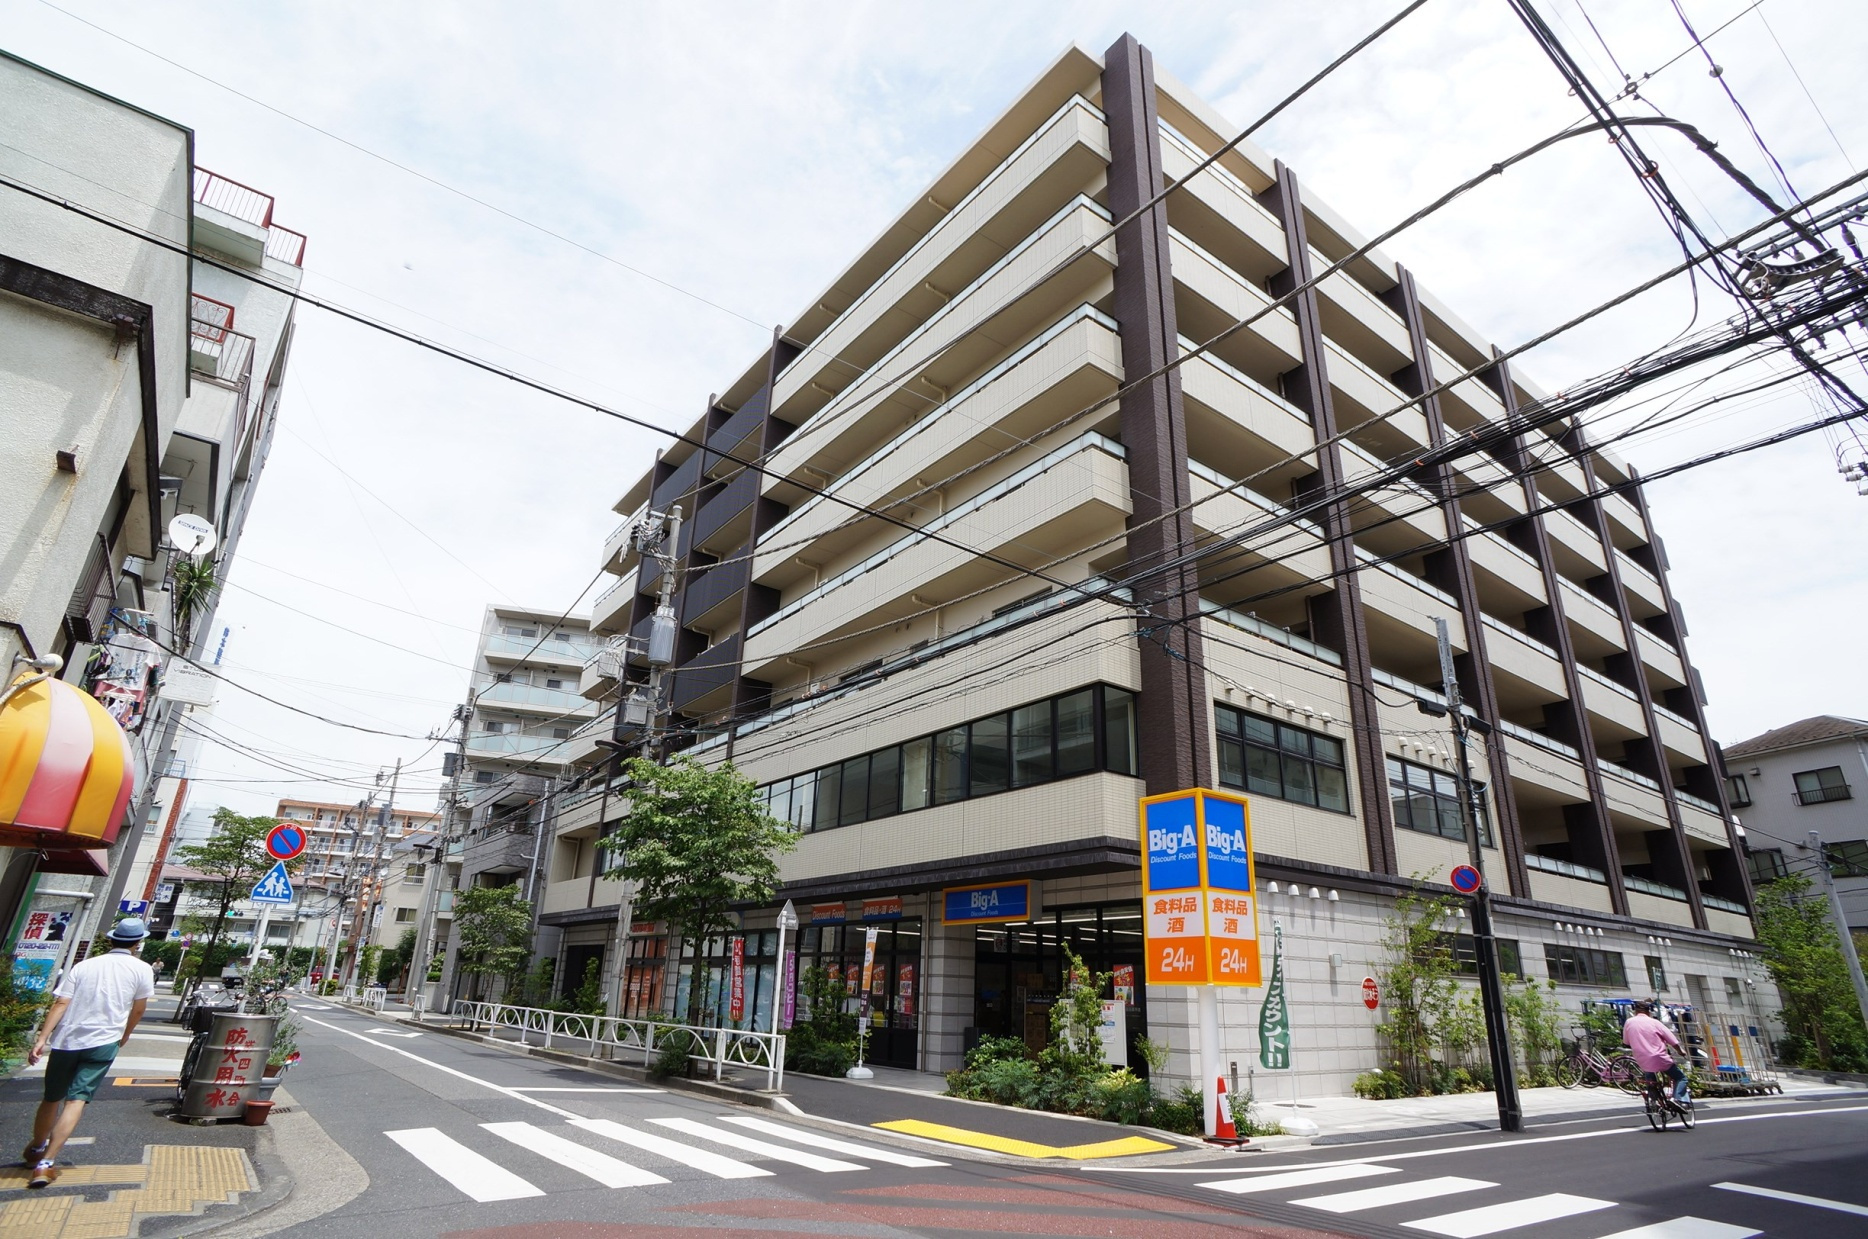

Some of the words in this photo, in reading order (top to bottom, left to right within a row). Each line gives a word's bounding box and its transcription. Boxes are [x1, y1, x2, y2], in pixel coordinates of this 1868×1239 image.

[1150, 854, 1177, 864] Discount
[1178, 851, 1197, 861] Foods
[1208, 851, 1230, 862] Discount
[1231, 855, 1247, 864] Foods
[127, 901, 141, 911] P
[812, 910, 831, 920] Discount
[831, 908, 846, 919] Foods
[1153, 896, 1198, 915] 食料品
[1212, 897, 1248, 916] 食料品
[24, 912, 49, 940] 探偵
[1166, 917, 1185, 933] 酒
[1223, 917, 1239, 934] 酒
[1161, 946, 1195, 973] 24H
[1220, 947, 1248, 974] 24H
[203, 1027, 248, 1109] 防火用水
